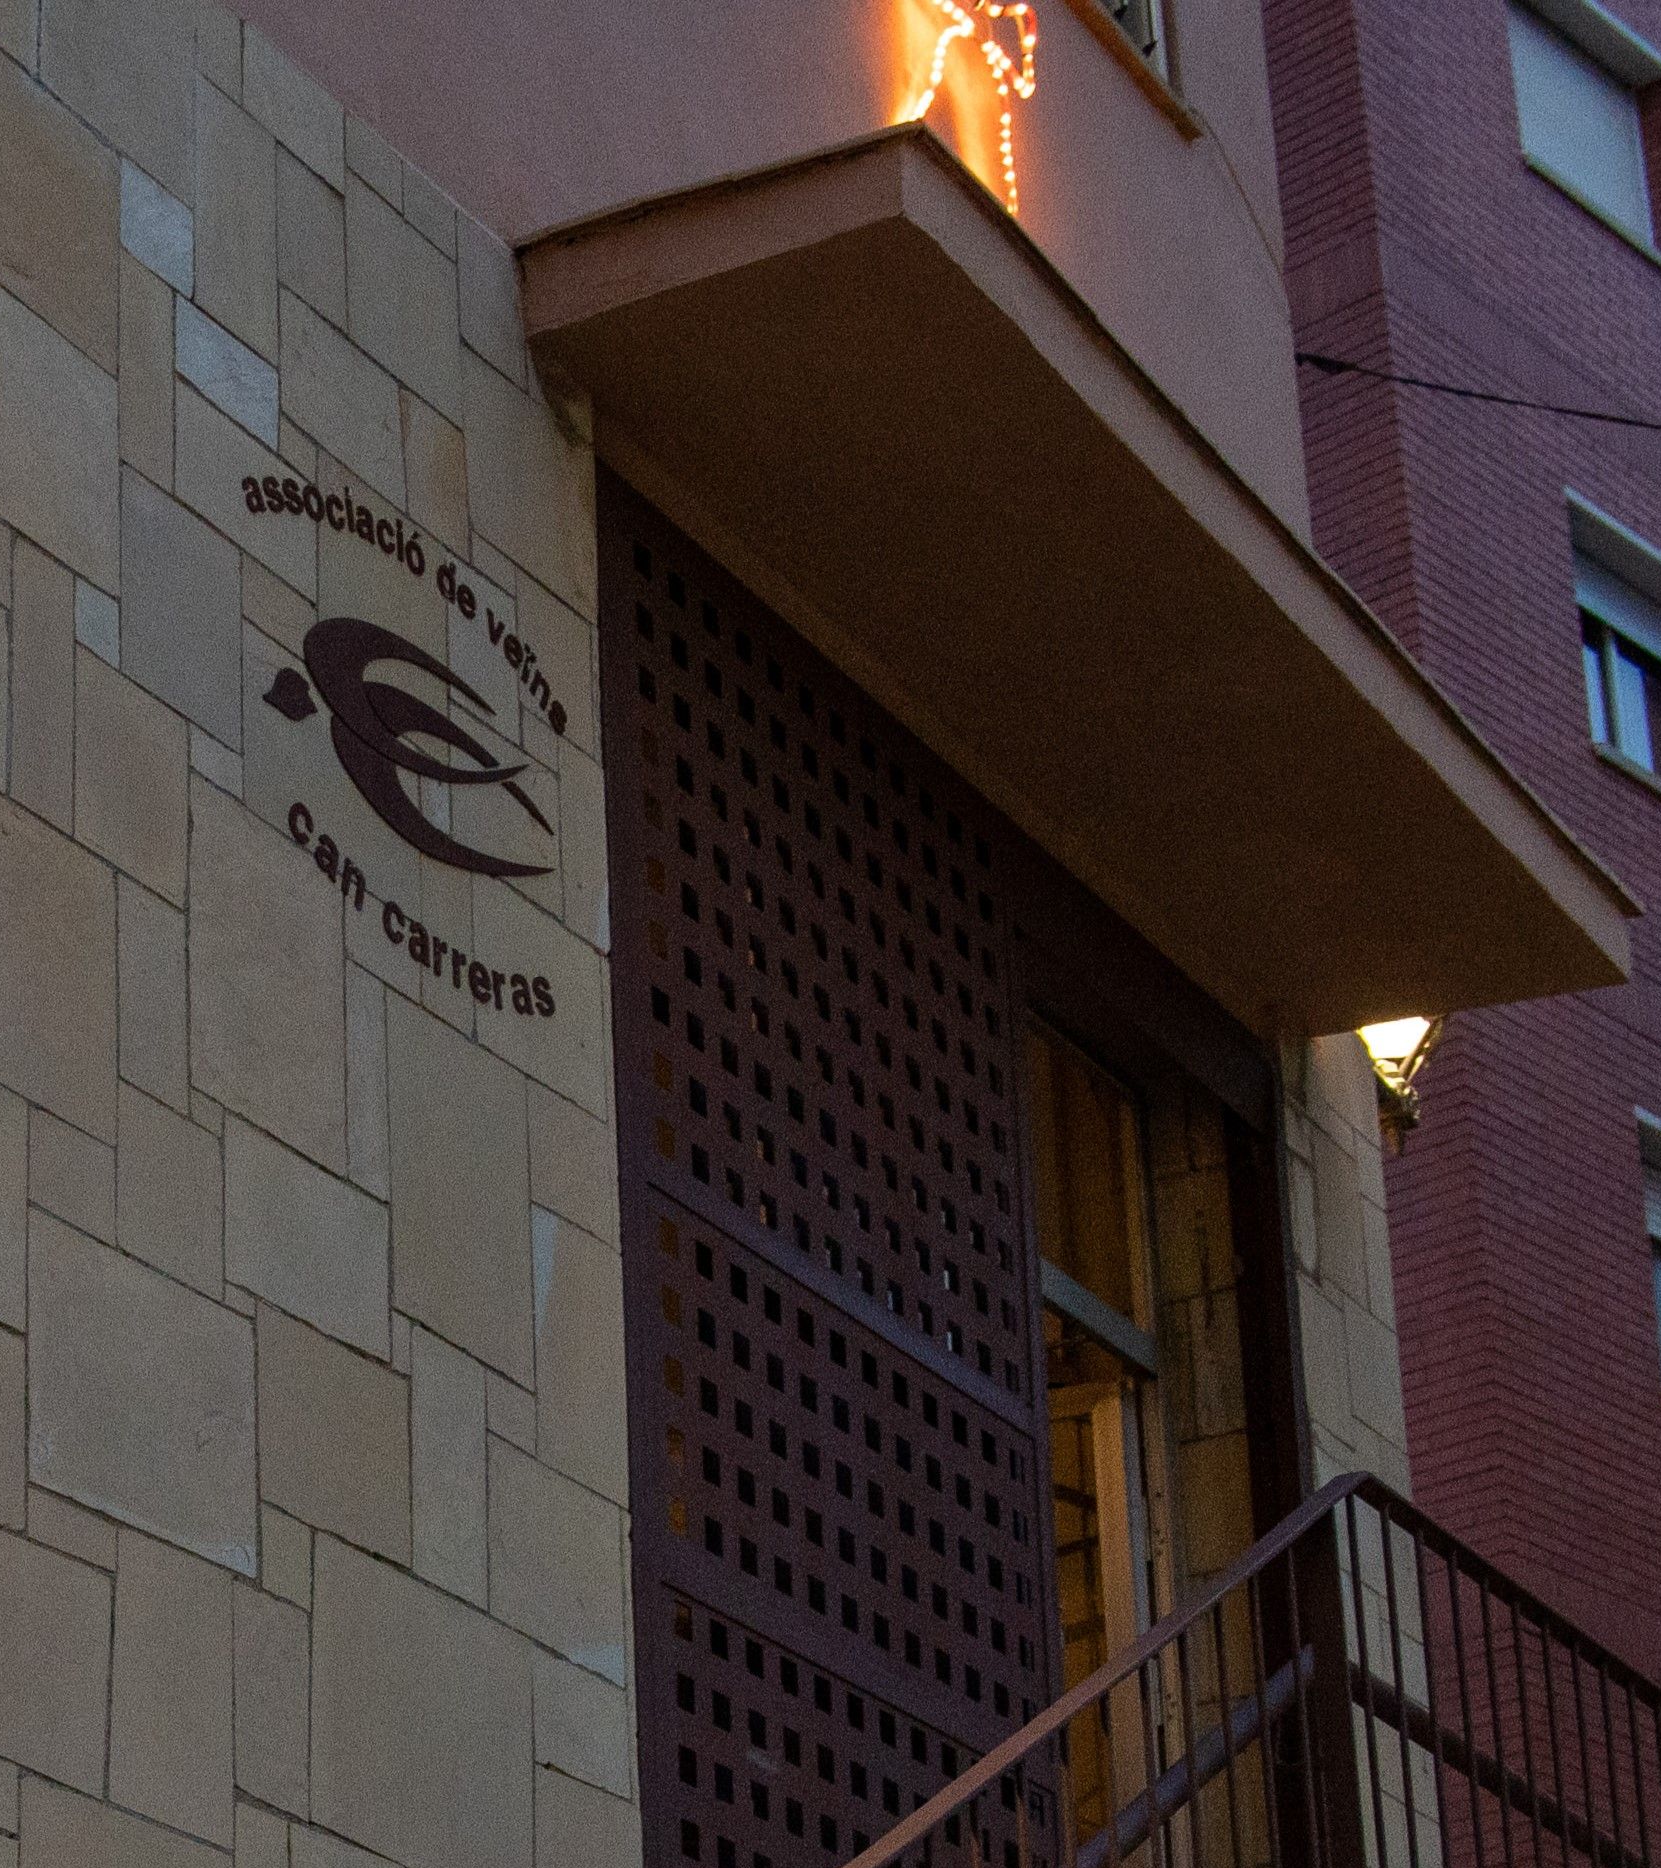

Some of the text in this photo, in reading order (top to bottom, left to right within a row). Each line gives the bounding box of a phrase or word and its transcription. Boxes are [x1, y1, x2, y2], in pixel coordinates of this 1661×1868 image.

[242, 472, 568, 736] associació de veïns
[287, 802, 556, 1018] can carreras
